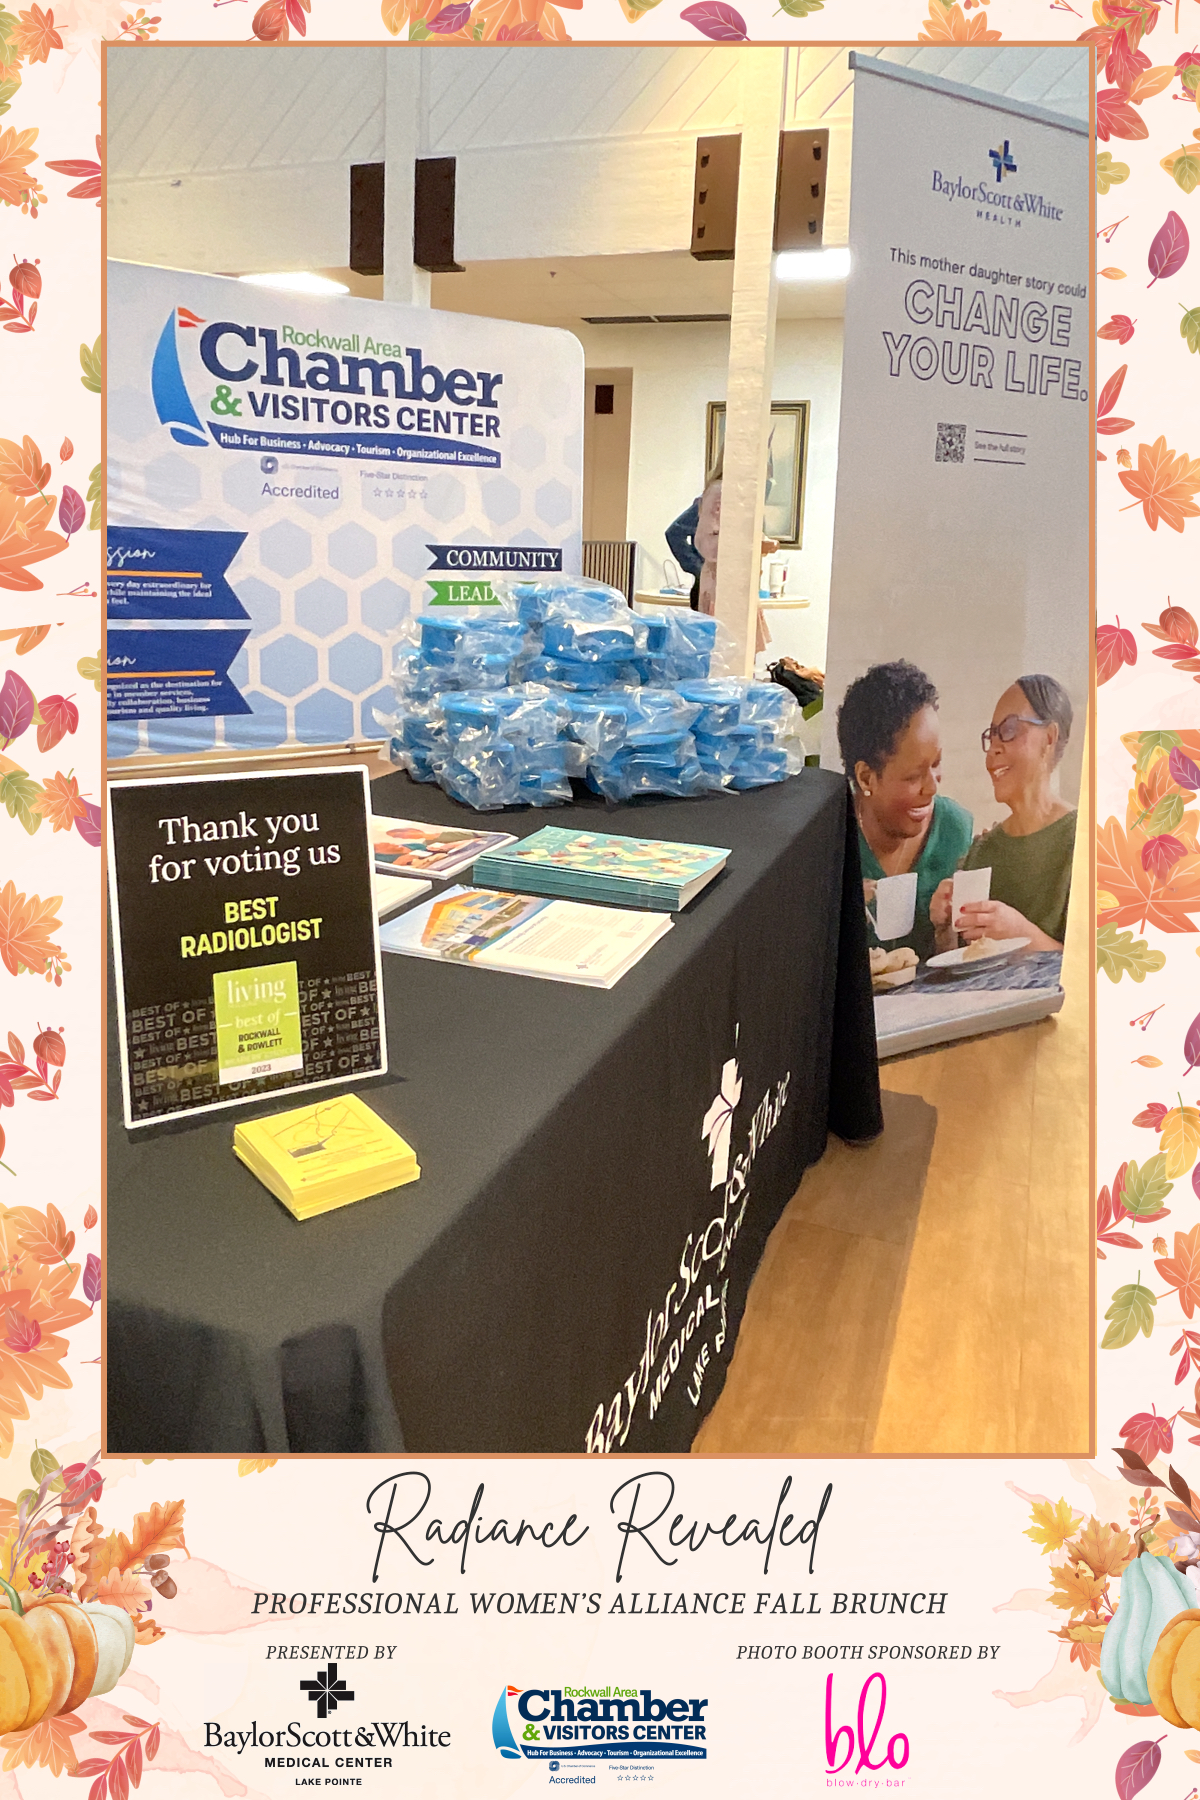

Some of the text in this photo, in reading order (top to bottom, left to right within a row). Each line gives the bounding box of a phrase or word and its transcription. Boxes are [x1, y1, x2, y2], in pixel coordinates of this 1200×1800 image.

[976, 210, 1021, 228] HEALTH
[890, 247, 1087, 299] This mother daughter story could
[904, 279, 1072, 348] CHANGE
[282, 325, 402, 358] Rockwall Area
[199, 321, 503, 408] Chamber
[882, 331, 1089, 402] YOUR LIFE.
[210, 384, 501, 438] & VISITORS CENTER
[220, 432, 497, 464] Hub For Business Advocacy Tourism Organizational Excellence
[261, 482, 339, 500] Accredited
[446, 550, 559, 568] COMMUNITY
[126, 581, 140, 589] day
[142, 581, 198, 590] extraordinary
[127, 589, 178, 598] maintaining
[193, 589, 212, 598] ideal
[164, 680, 210, 688] destination
[211, 679, 223, 687] for
[158, 811, 320, 846] Thank you
[149, 844, 342, 884] for voting us
[224, 896, 279, 924] BEST
[180, 918, 323, 958] RADIOLOGIST
[347, 970, 371, 982] BEST
[227, 977, 287, 1004] living
[359, 979, 377, 994] BE
[132, 1005, 161, 1018] BEST
[164, 1002, 180, 1012] OF
[310, 1001, 325, 1012] OF
[350, 993, 376, 1005] BEST
[132, 1008, 206, 1033] BEST OF
[235, 1007, 282, 1029] best of
[302, 1010, 331, 1027] EST
[335, 1007, 357, 1021] OF
[311, 1025, 326, 1036] OF
[351, 1017, 376, 1029] BEST
[132, 1030, 161, 1045] BEST
[164, 1028, 181, 1038] OF
[176, 1031, 217, 1051] BEST
[238, 1028, 282, 1042] ROCKWALL
[360, 1027, 380, 1041] BE
[237, 1037, 283, 1054] & ROWLETT
[133, 1057, 162, 1071] BEST
[165, 1053, 182, 1064] OF
[251, 1063, 272, 1075] 2023
[338, 1054, 360, 1068] OF
[133, 1059, 207, 1086] BEST OF
[135, 1083, 164, 1097] BEST
[180, 1082, 220, 1102] BEST
[649, 1284, 720, 1420] MEDICAL
[687, 1342, 710, 1406] LAKE
